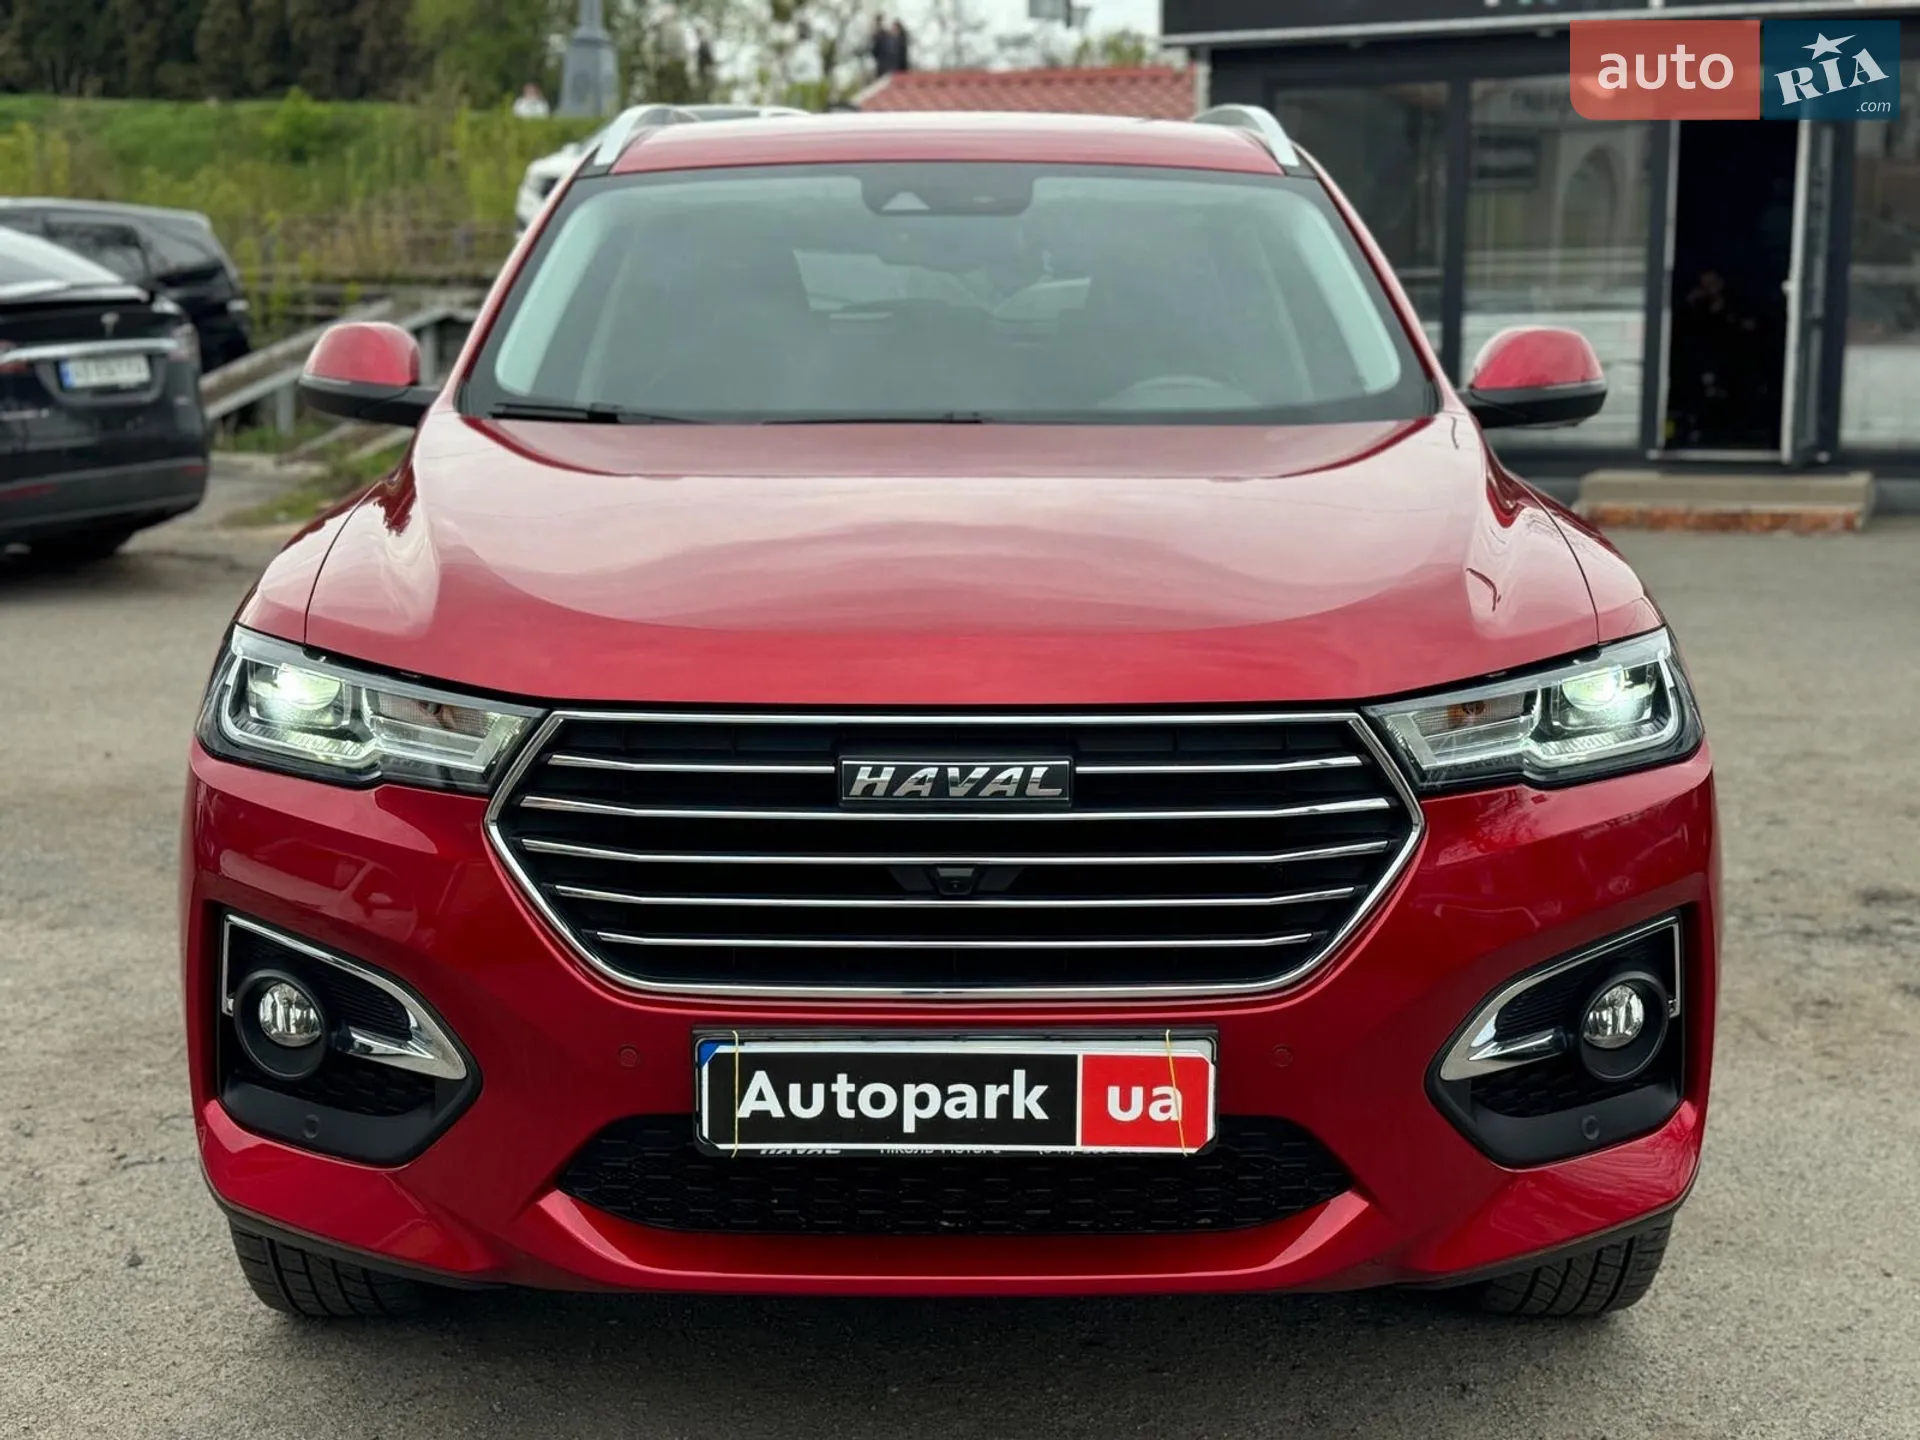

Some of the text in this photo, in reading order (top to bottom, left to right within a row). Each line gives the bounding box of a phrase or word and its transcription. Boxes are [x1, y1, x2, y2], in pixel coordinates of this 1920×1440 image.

[849, 766, 1062, 797] HAVAL
[737, 1069, 1183, 1133] Autopark ua
